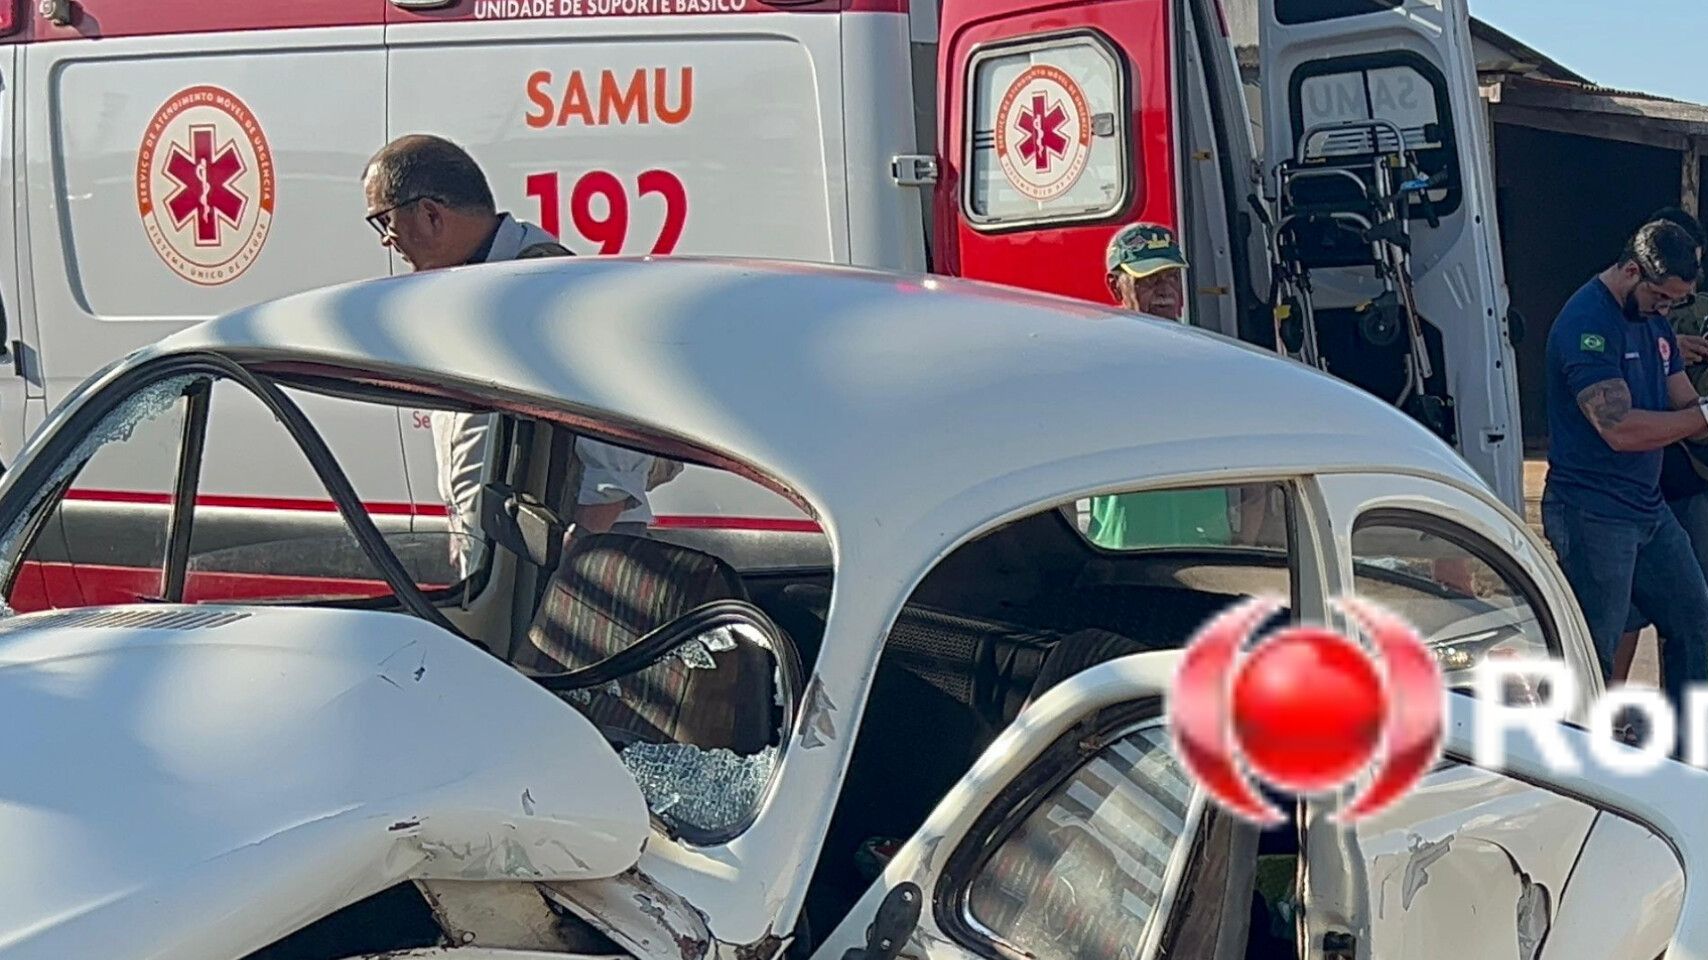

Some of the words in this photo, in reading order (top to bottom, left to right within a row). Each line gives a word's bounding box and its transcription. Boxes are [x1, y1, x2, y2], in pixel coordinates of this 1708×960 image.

[474, 0, 555, 19] UNIDADE
[560, 0, 582, 15] DE
[526, 67, 692, 128] SAMU
[526, 169, 687, 255] 192
